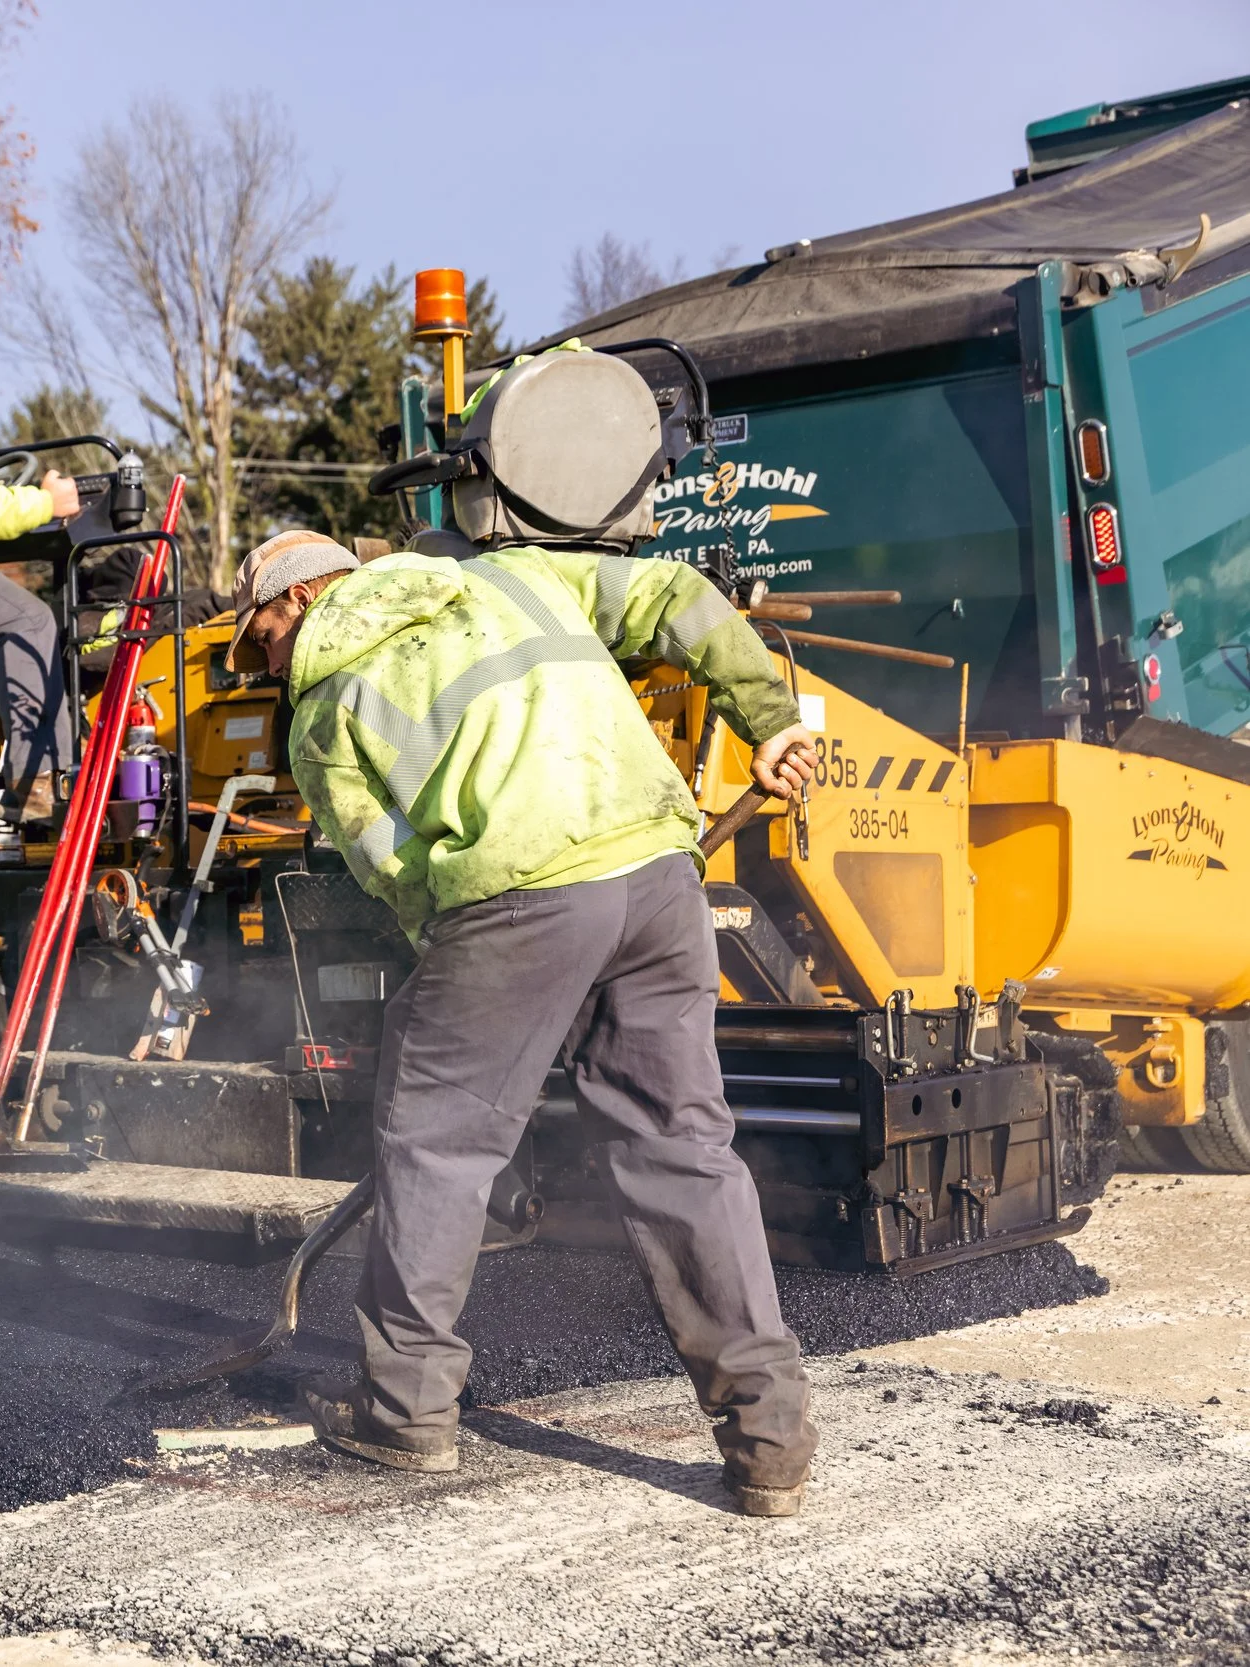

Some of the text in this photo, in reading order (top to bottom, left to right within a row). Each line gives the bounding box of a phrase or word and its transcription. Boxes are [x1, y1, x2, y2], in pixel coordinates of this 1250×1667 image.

[654, 473, 714, 503] ons
[737, 463, 817, 497] Hohl
[655, 504, 772, 537] Paving
[748, 538, 774, 555] PA.
[731, 558, 812, 578] aving.com
[814, 736, 858, 788] 85B
[849, 808, 909, 839] 385-04
[1189, 805, 1224, 849] Hohl
[1152, 837, 1205, 880] Paving
